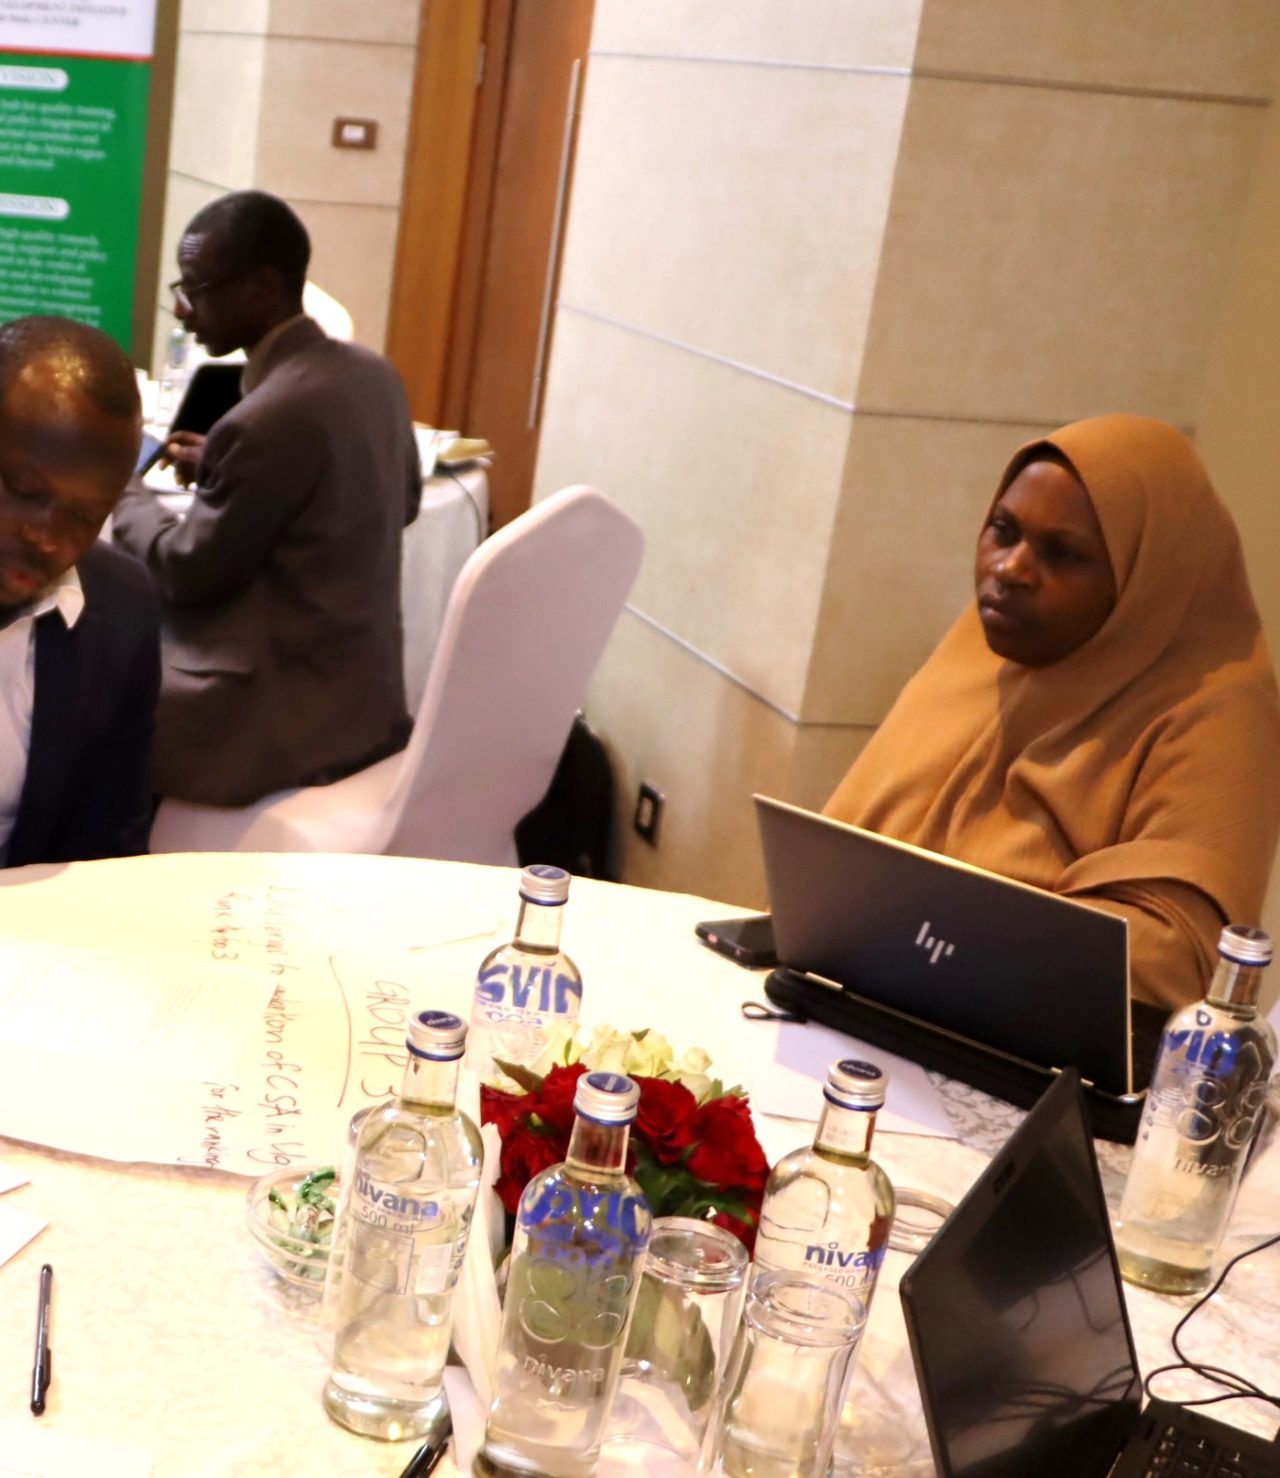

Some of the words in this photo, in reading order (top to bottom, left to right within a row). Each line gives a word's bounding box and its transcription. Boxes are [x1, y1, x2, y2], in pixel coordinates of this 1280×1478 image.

[261, 1050, 302, 1073] of
[202, 1081, 241, 1099] for
[257, 1074, 303, 1118] CSA
[361, 1079, 402, 1098] 3
[265, 1122, 297, 1134] in
[361, 1205, 388, 1228] 500
[523, 1353, 605, 1383] nivana
